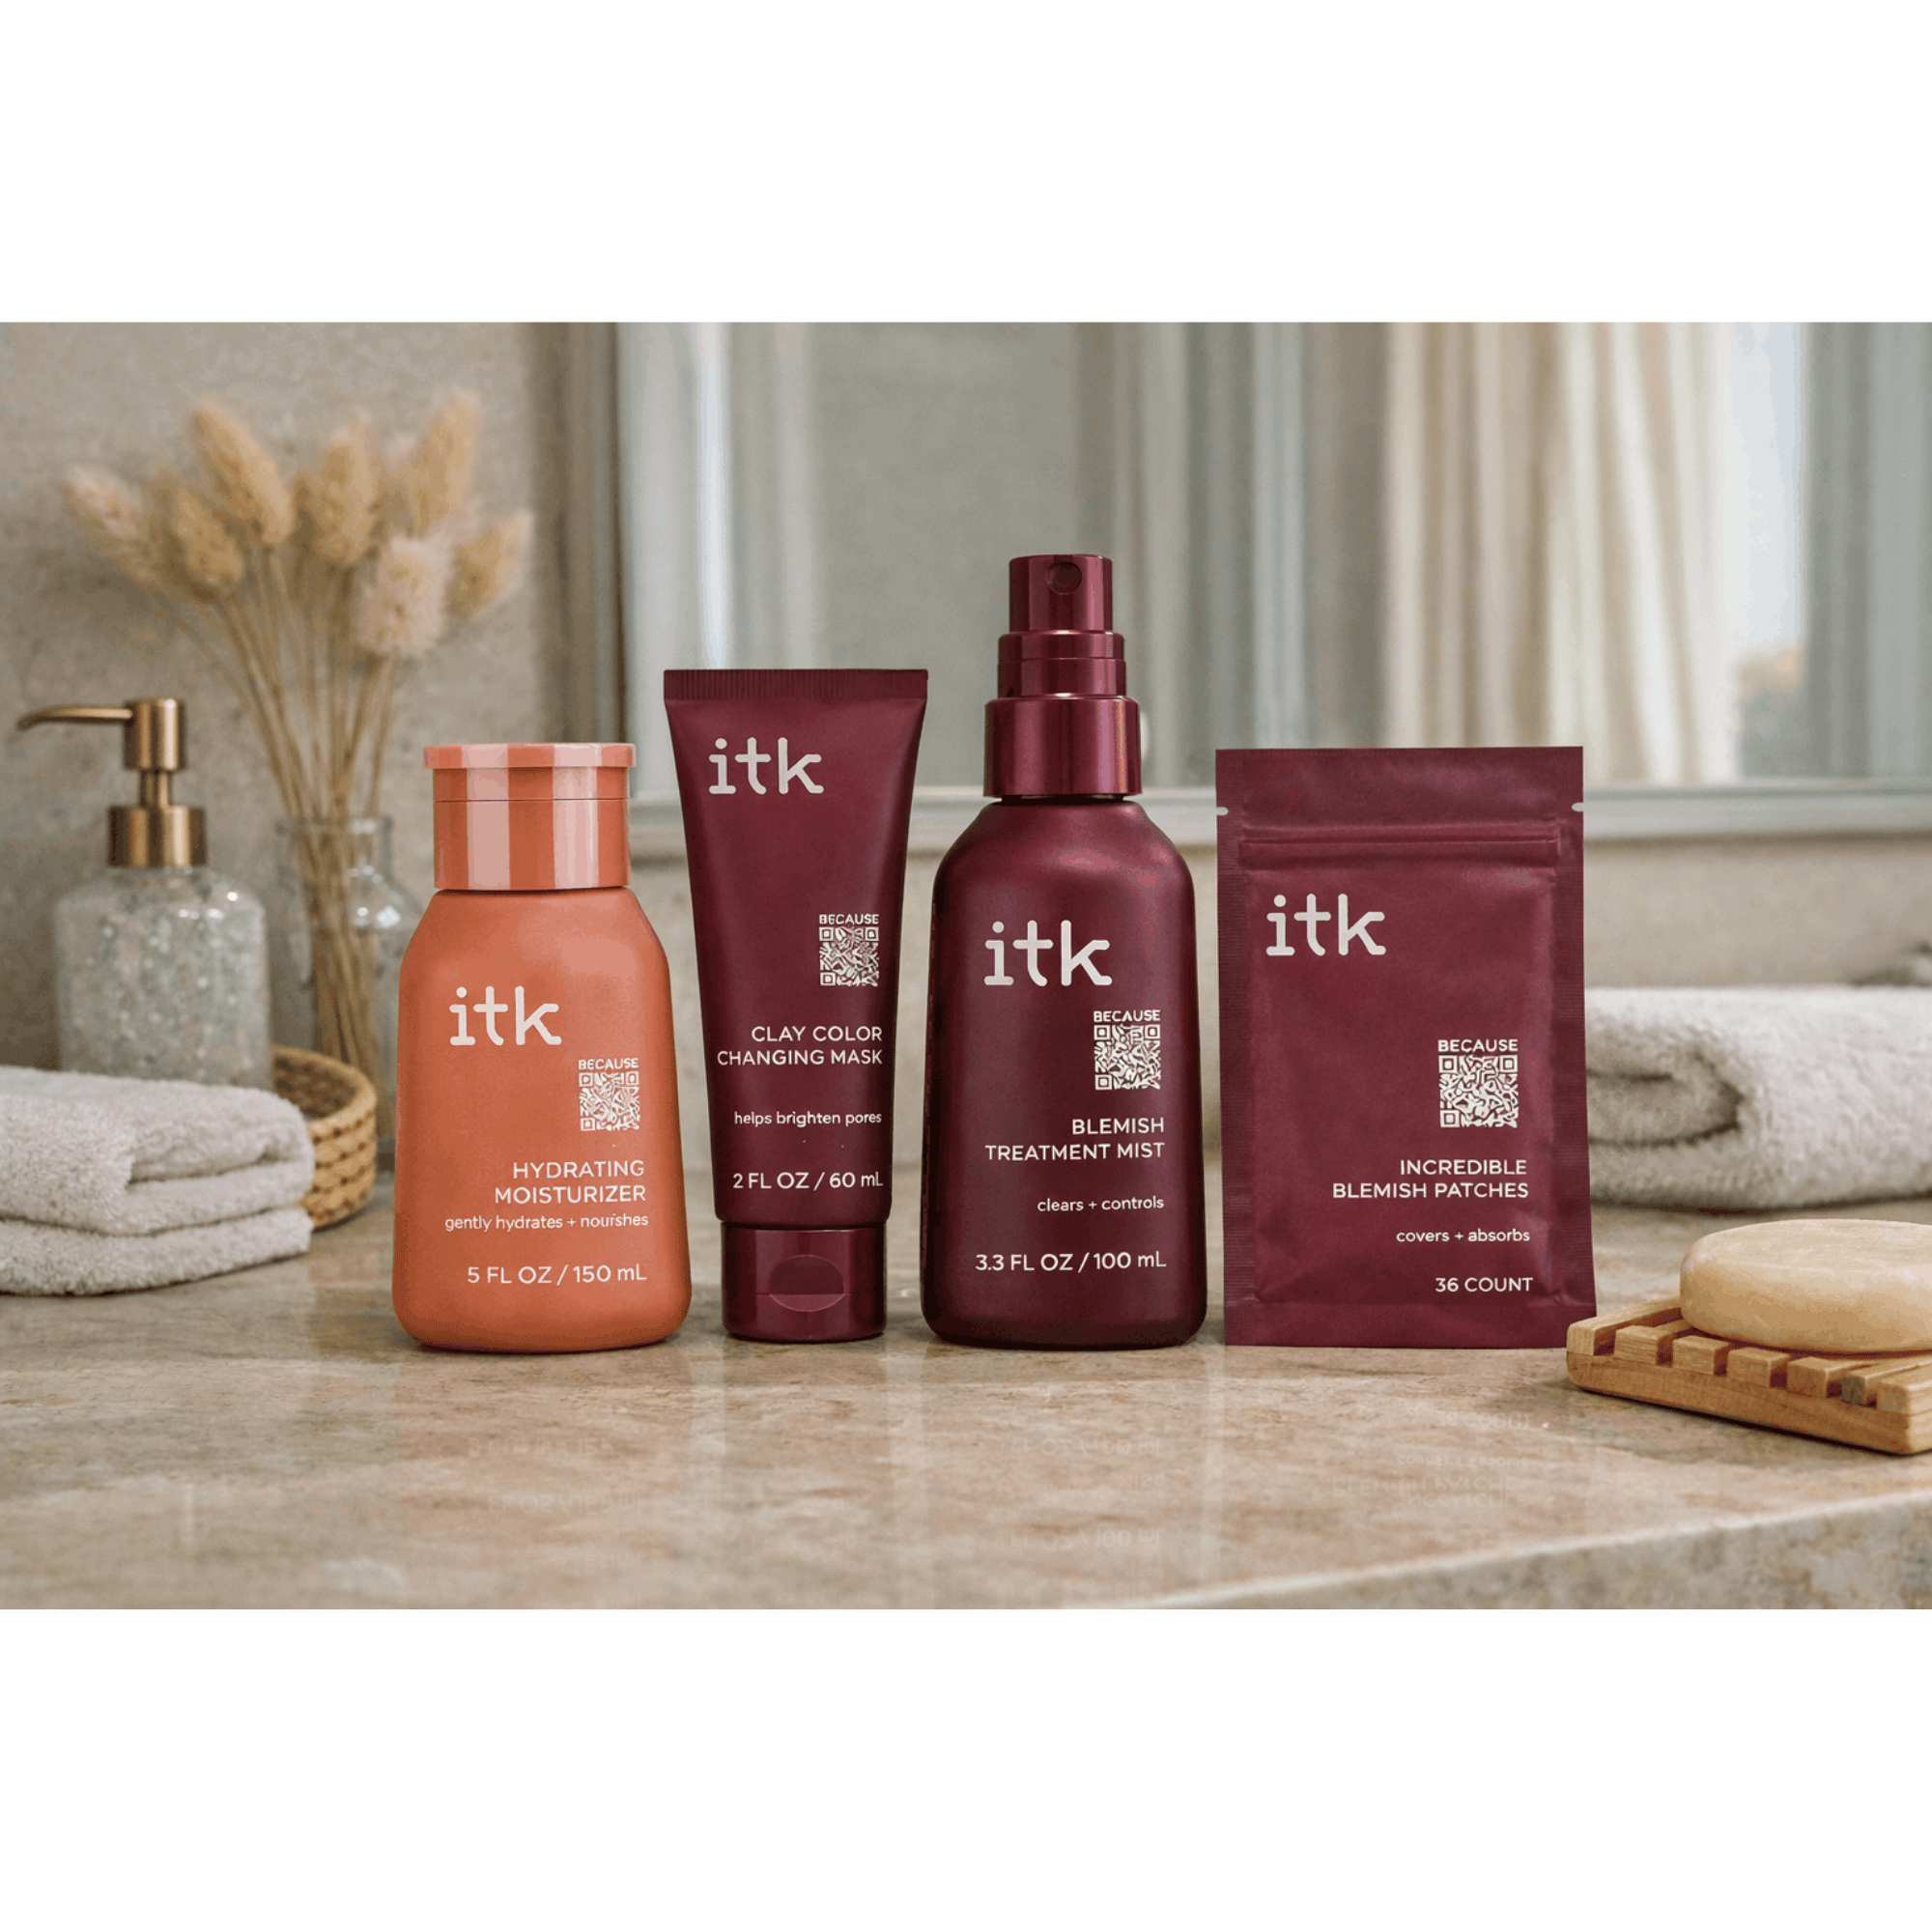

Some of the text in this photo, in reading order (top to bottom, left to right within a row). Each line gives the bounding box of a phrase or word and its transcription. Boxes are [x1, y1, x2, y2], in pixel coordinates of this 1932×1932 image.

[708, 736, 825, 795] itk
[818, 913, 879, 925] BECAUSE
[1265, 893, 1387, 956] itk
[983, 920, 1113, 987] itk
[448, 985, 563, 1046] itk
[1094, 1009, 1161, 1023] BECAUSE
[751, 1025, 883, 1042] CLAY COLOR
[1437, 1038, 1519, 1053] BECAUSE
[578, 1057, 639, 1070] BECAUSE
[717, 1048, 882, 1066] CHANGING MASK
[734, 1110, 882, 1128] helps brighten pores
[1072, 1116, 1165, 1135] BLEMISH
[984, 1142, 1166, 1161] TREATMENT MIST
[513, 1159, 644, 1179] HYDRATING
[1400, 1158, 1527, 1176] INCREDIBLE
[732, 1171, 884, 1191] 2 FL OZ / 60 mL
[1332, 1181, 1529, 1199] BLEMISH PATCHES
[495, 1184, 646, 1205] MOISTURIZER
[1037, 1195, 1165, 1212] clears + controls
[444, 1212, 649, 1233] gently hydrates + nourishes
[1395, 1228, 1531, 1242] covers + absorbs
[975, 1250, 1167, 1273] 3.3 FL OZ / 100 mL
[467, 1263, 647, 1287] 5 FL OZ / 150 mL
[1435, 1276, 1534, 1293] 36 COUNT
